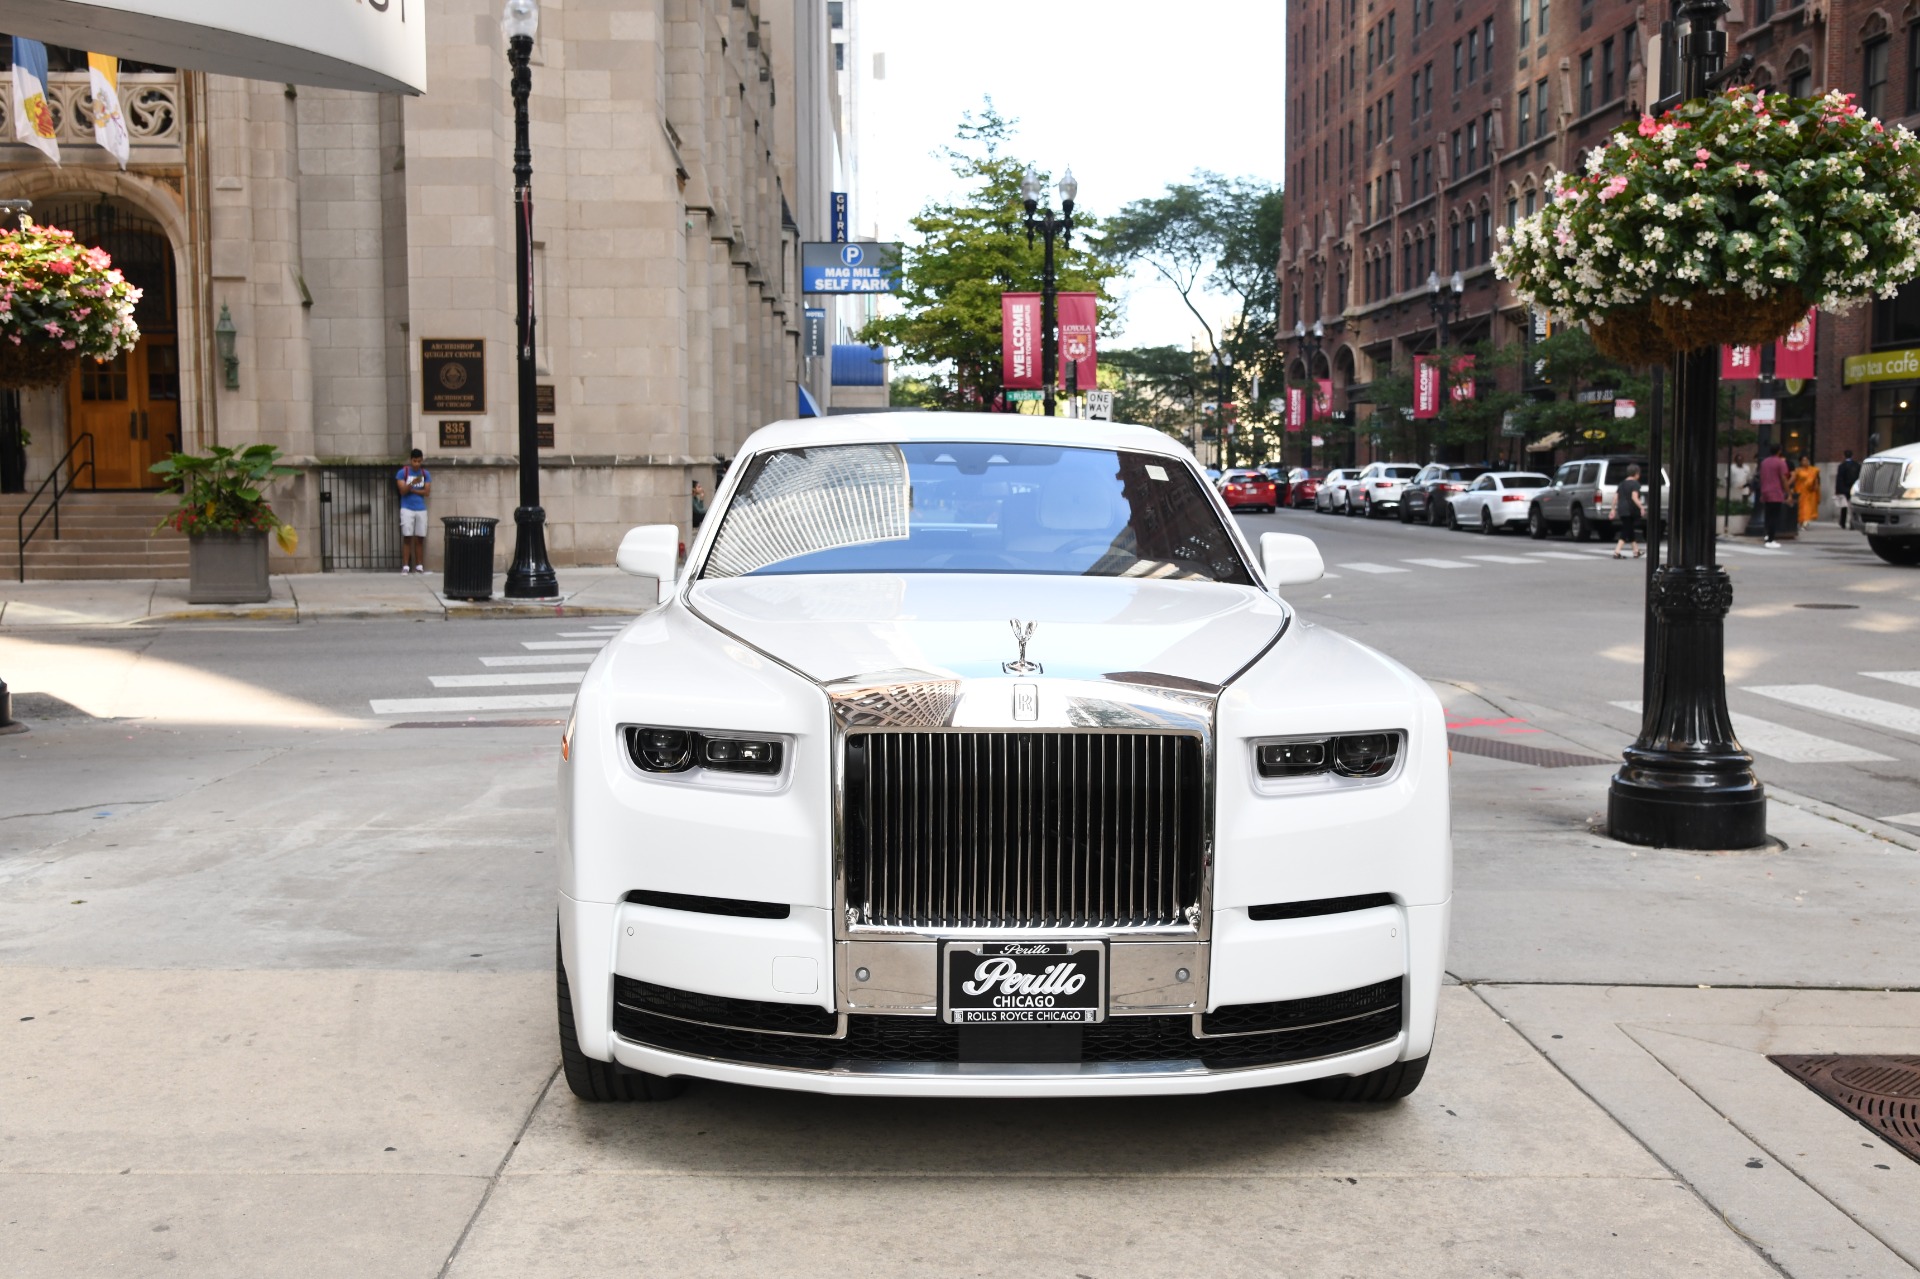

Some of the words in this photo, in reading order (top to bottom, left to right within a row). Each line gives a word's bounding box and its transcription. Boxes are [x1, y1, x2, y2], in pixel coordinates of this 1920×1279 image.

[836, 195, 845, 242] GHIRA
[847, 247, 859, 263] P
[825, 268, 850, 278] MAG
[853, 268, 880, 278] MILE
[815, 279, 849, 290] SELF
[852, 279, 890, 290] PARK
[1012, 304, 1025, 378] WELCOME
[1886, 351, 1919, 374] café
[1014, 392, 1033, 400] RUSH
[1090, 394, 1109, 402] ONE
[1089, 403, 1109, 412] WAY
[445, 423, 465, 433] 835
[999, 944, 1051, 955] Perillo
[962, 957, 1087, 996] Perillo
[993, 995, 1055, 1008] CHICAGO
[967, 1011, 997, 1021] ROLLS
[1000, 1011, 1034, 1021] ROYCE
[1036, 1011, 1081, 1021] CHICAGO
